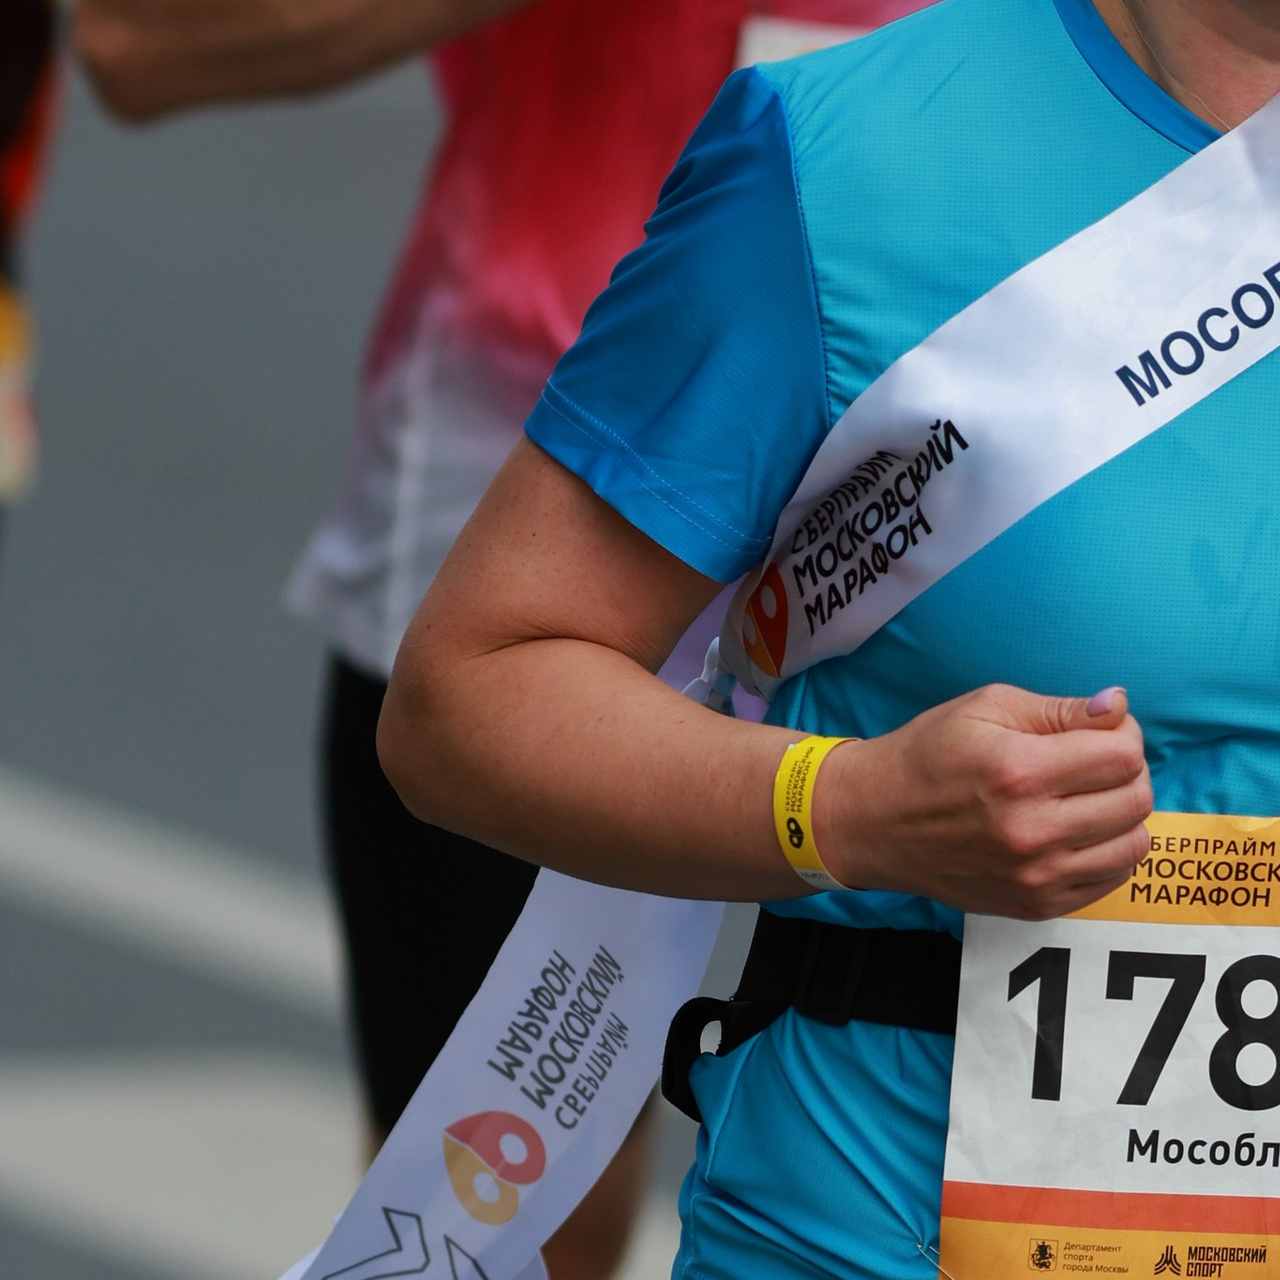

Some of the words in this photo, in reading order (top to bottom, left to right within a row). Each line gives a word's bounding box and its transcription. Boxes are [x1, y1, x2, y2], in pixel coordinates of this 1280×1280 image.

[792, 418, 969, 597] МОСКОВСКИЙ
[803, 505, 933, 637] МАРАФОН
[1150, 836, 1276, 856] БЕРПРАЙМ
[1130, 883, 1271, 907] МАРАФОН
[1064, 1242, 1122, 1253] Департамент
[1187, 1245, 1267, 1263] МОСКОВСКИЙ
[1063, 1253, 1093, 1262] спорта
[1063, 1263, 1093, 1272] города
[1095, 1264, 1129, 1273] Москвы
[1186, 1262, 1224, 1277] СПОРТ
